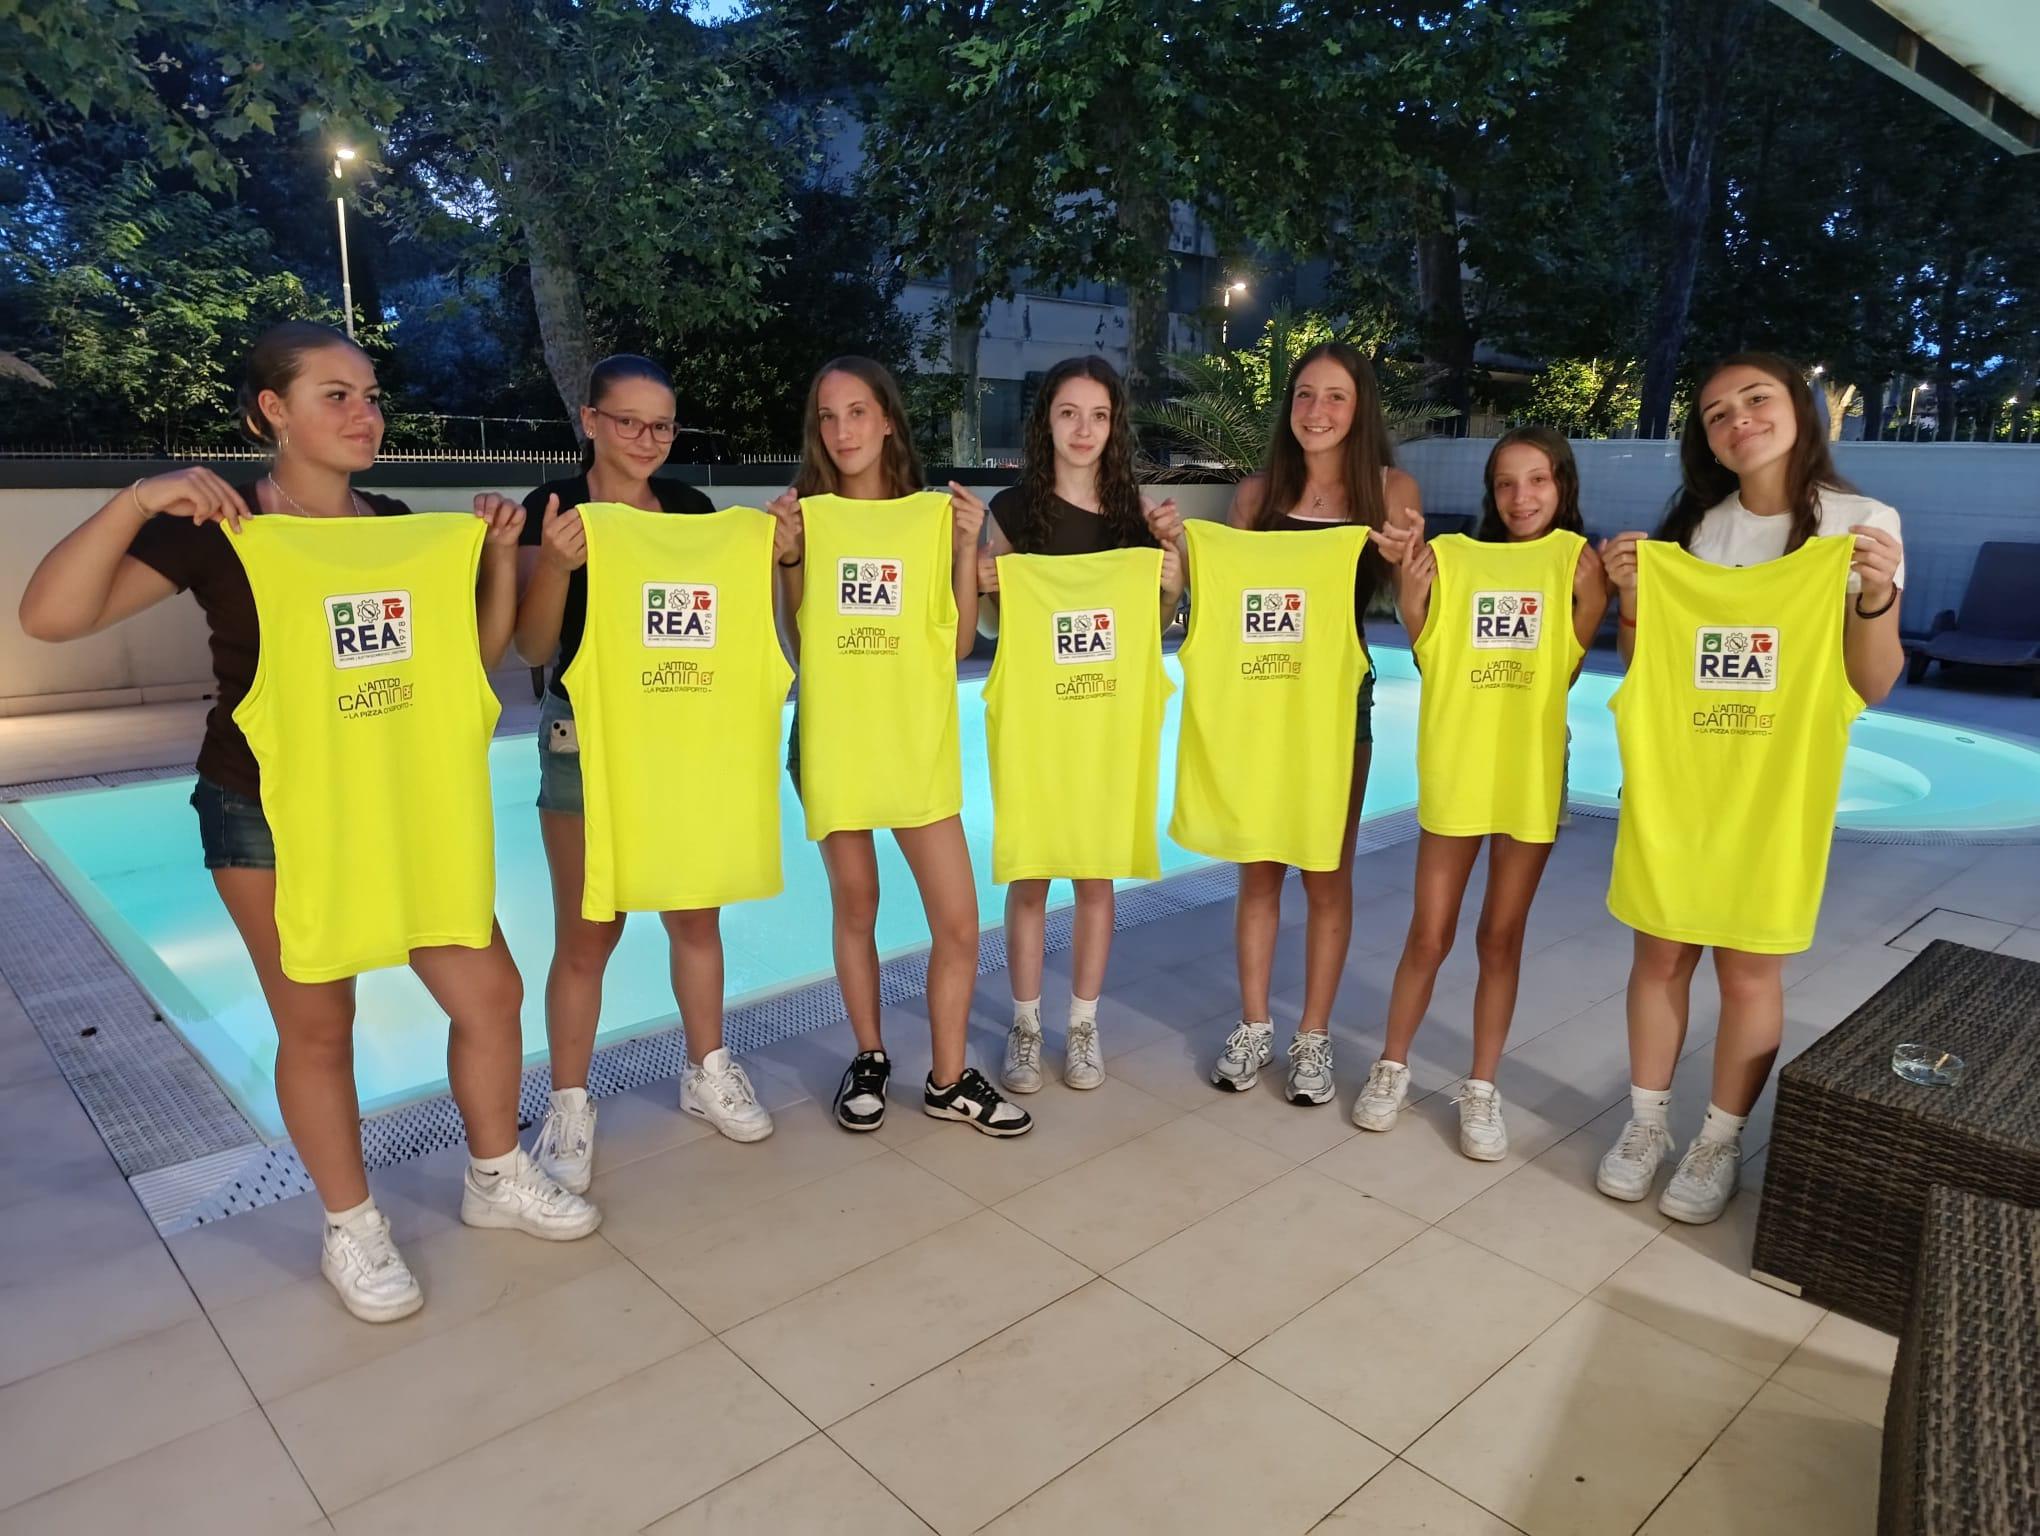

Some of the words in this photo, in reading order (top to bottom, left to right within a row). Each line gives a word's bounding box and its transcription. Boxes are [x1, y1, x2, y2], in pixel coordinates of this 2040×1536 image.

[842, 583, 890, 604] REA
[648, 611, 704, 635] REA
[1247, 612, 1294, 632] REA
[1477, 616, 1529, 637] REA
[335, 622, 400, 654] REA
[1058, 632, 1105, 653] REA
[1700, 655, 1764, 678] REA
[359, 678, 400, 693] L'ANTICO
[360, 708, 382, 717] PIZZA
